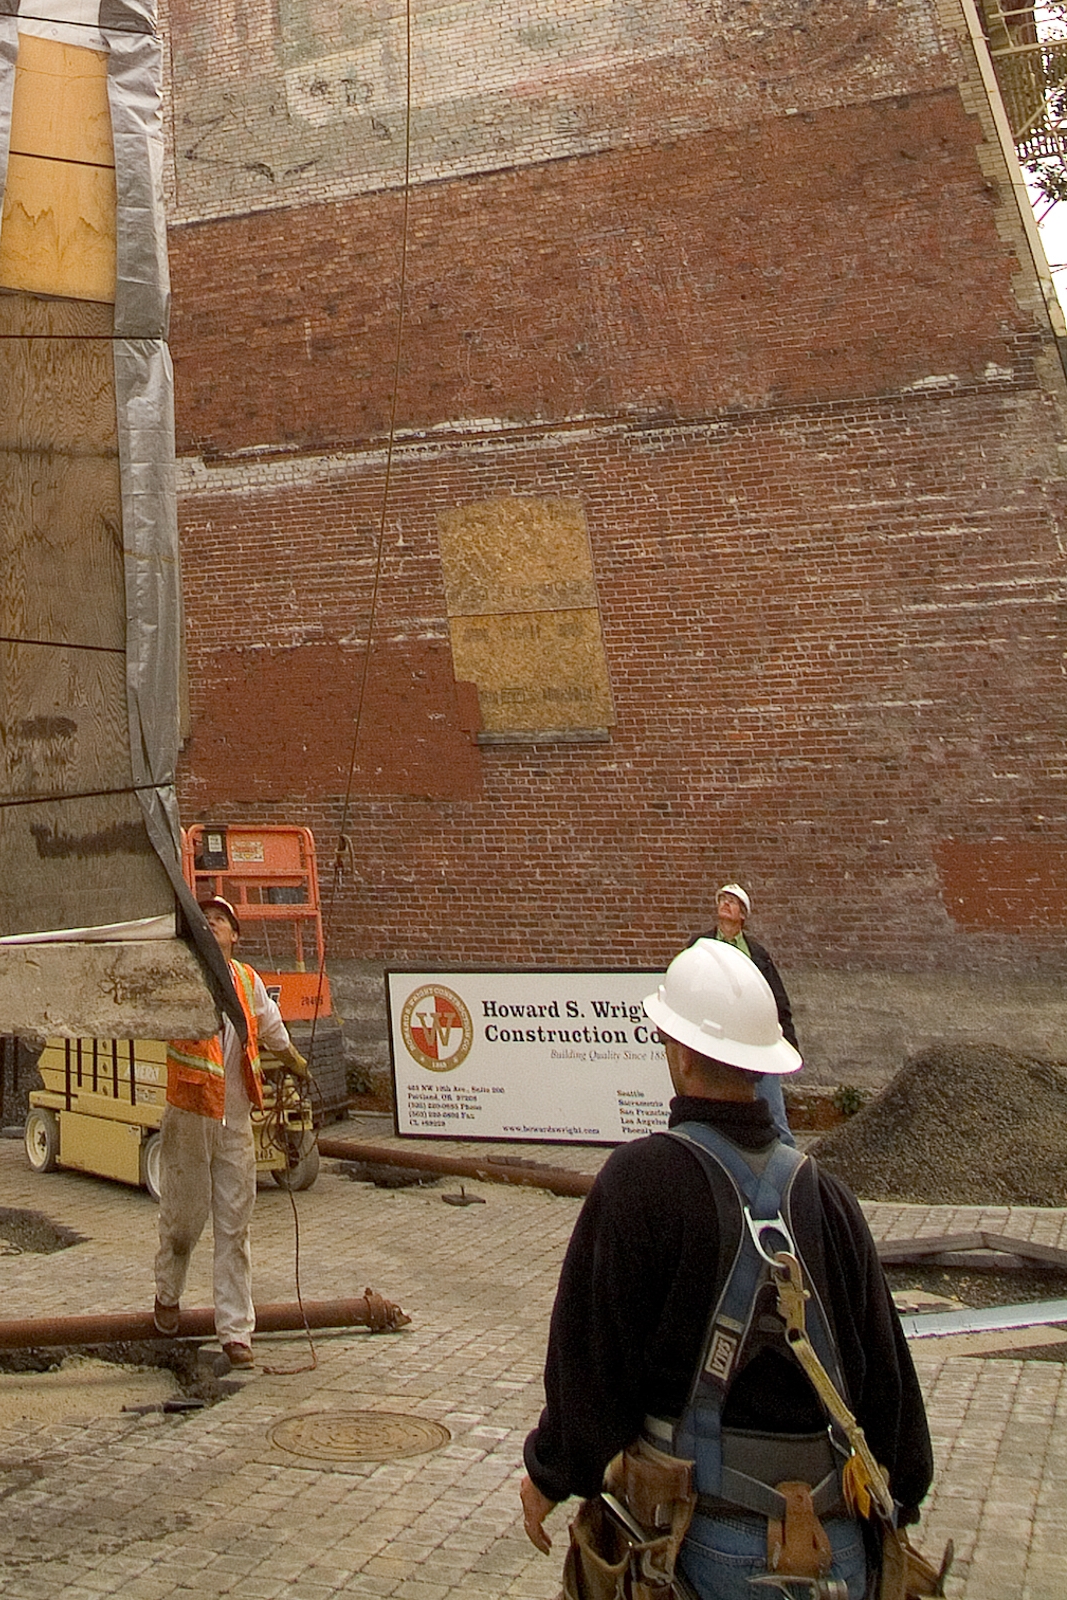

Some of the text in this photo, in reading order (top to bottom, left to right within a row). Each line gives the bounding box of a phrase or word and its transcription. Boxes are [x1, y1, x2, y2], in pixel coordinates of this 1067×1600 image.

[482, 1001, 648, 1023] Howard S. Wrig
[485, 1025, 628, 1044] Construction
[550, 1049, 586, 1060] Building
[589, 1050, 621, 1062] Quality
[623, 1051, 646, 1060] Since
